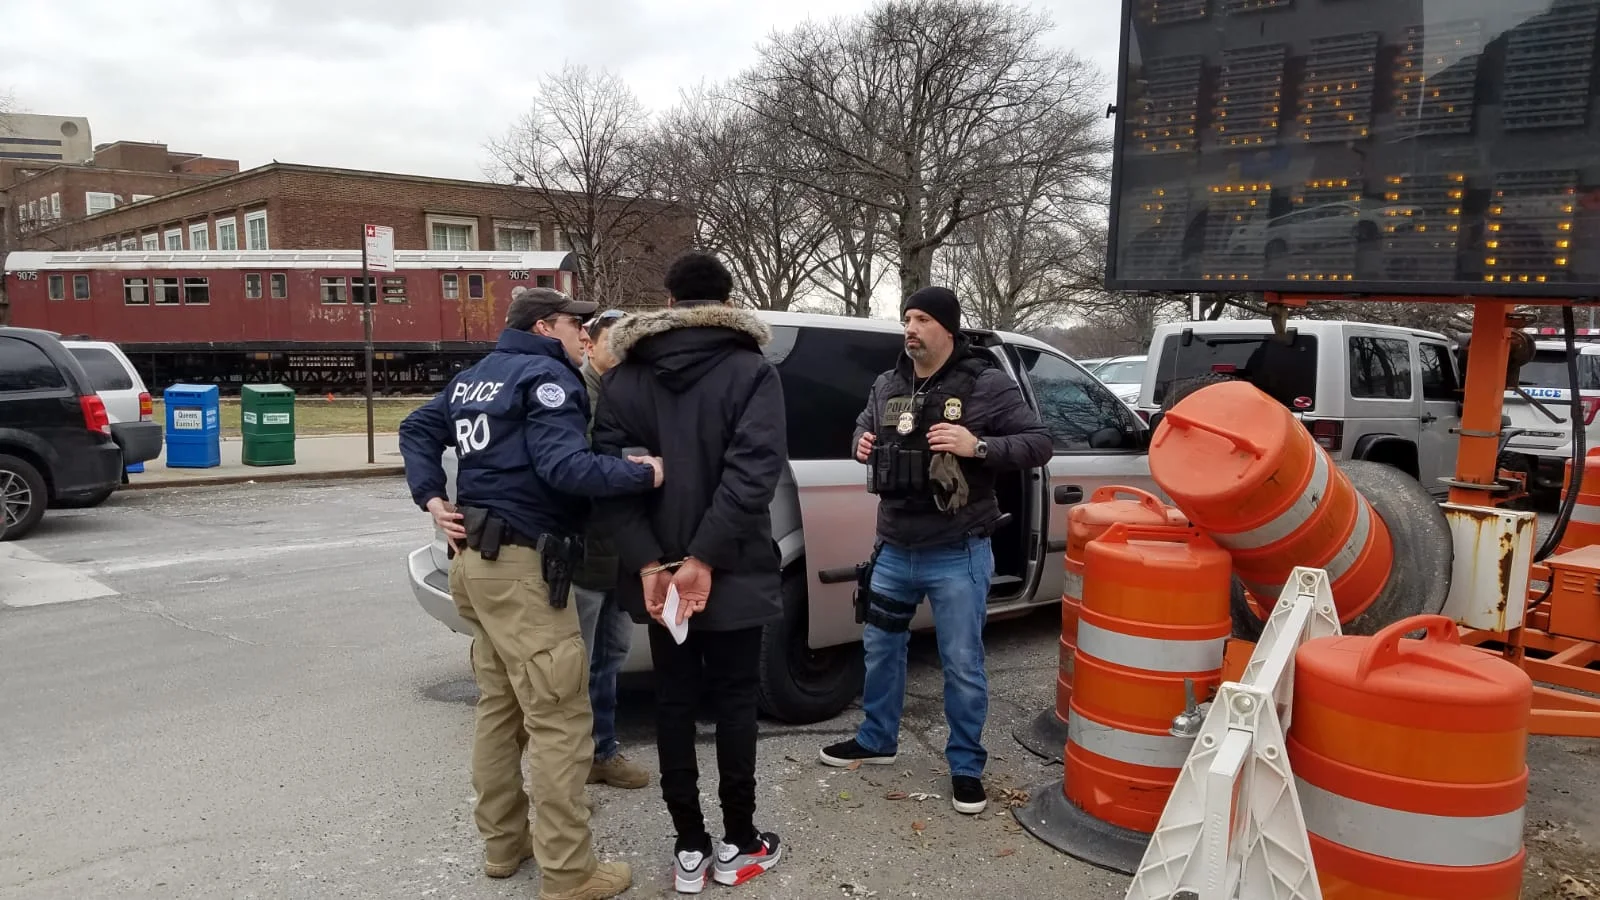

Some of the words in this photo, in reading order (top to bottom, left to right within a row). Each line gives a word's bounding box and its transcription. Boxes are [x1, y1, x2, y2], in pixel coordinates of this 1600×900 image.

[16, 271, 38, 281] 9075
[509, 270, 530, 280] 9075
[450, 380, 505, 404] POICE
[1513, 388, 1562, 398] OLICE
[177, 411, 198, 419] Queens
